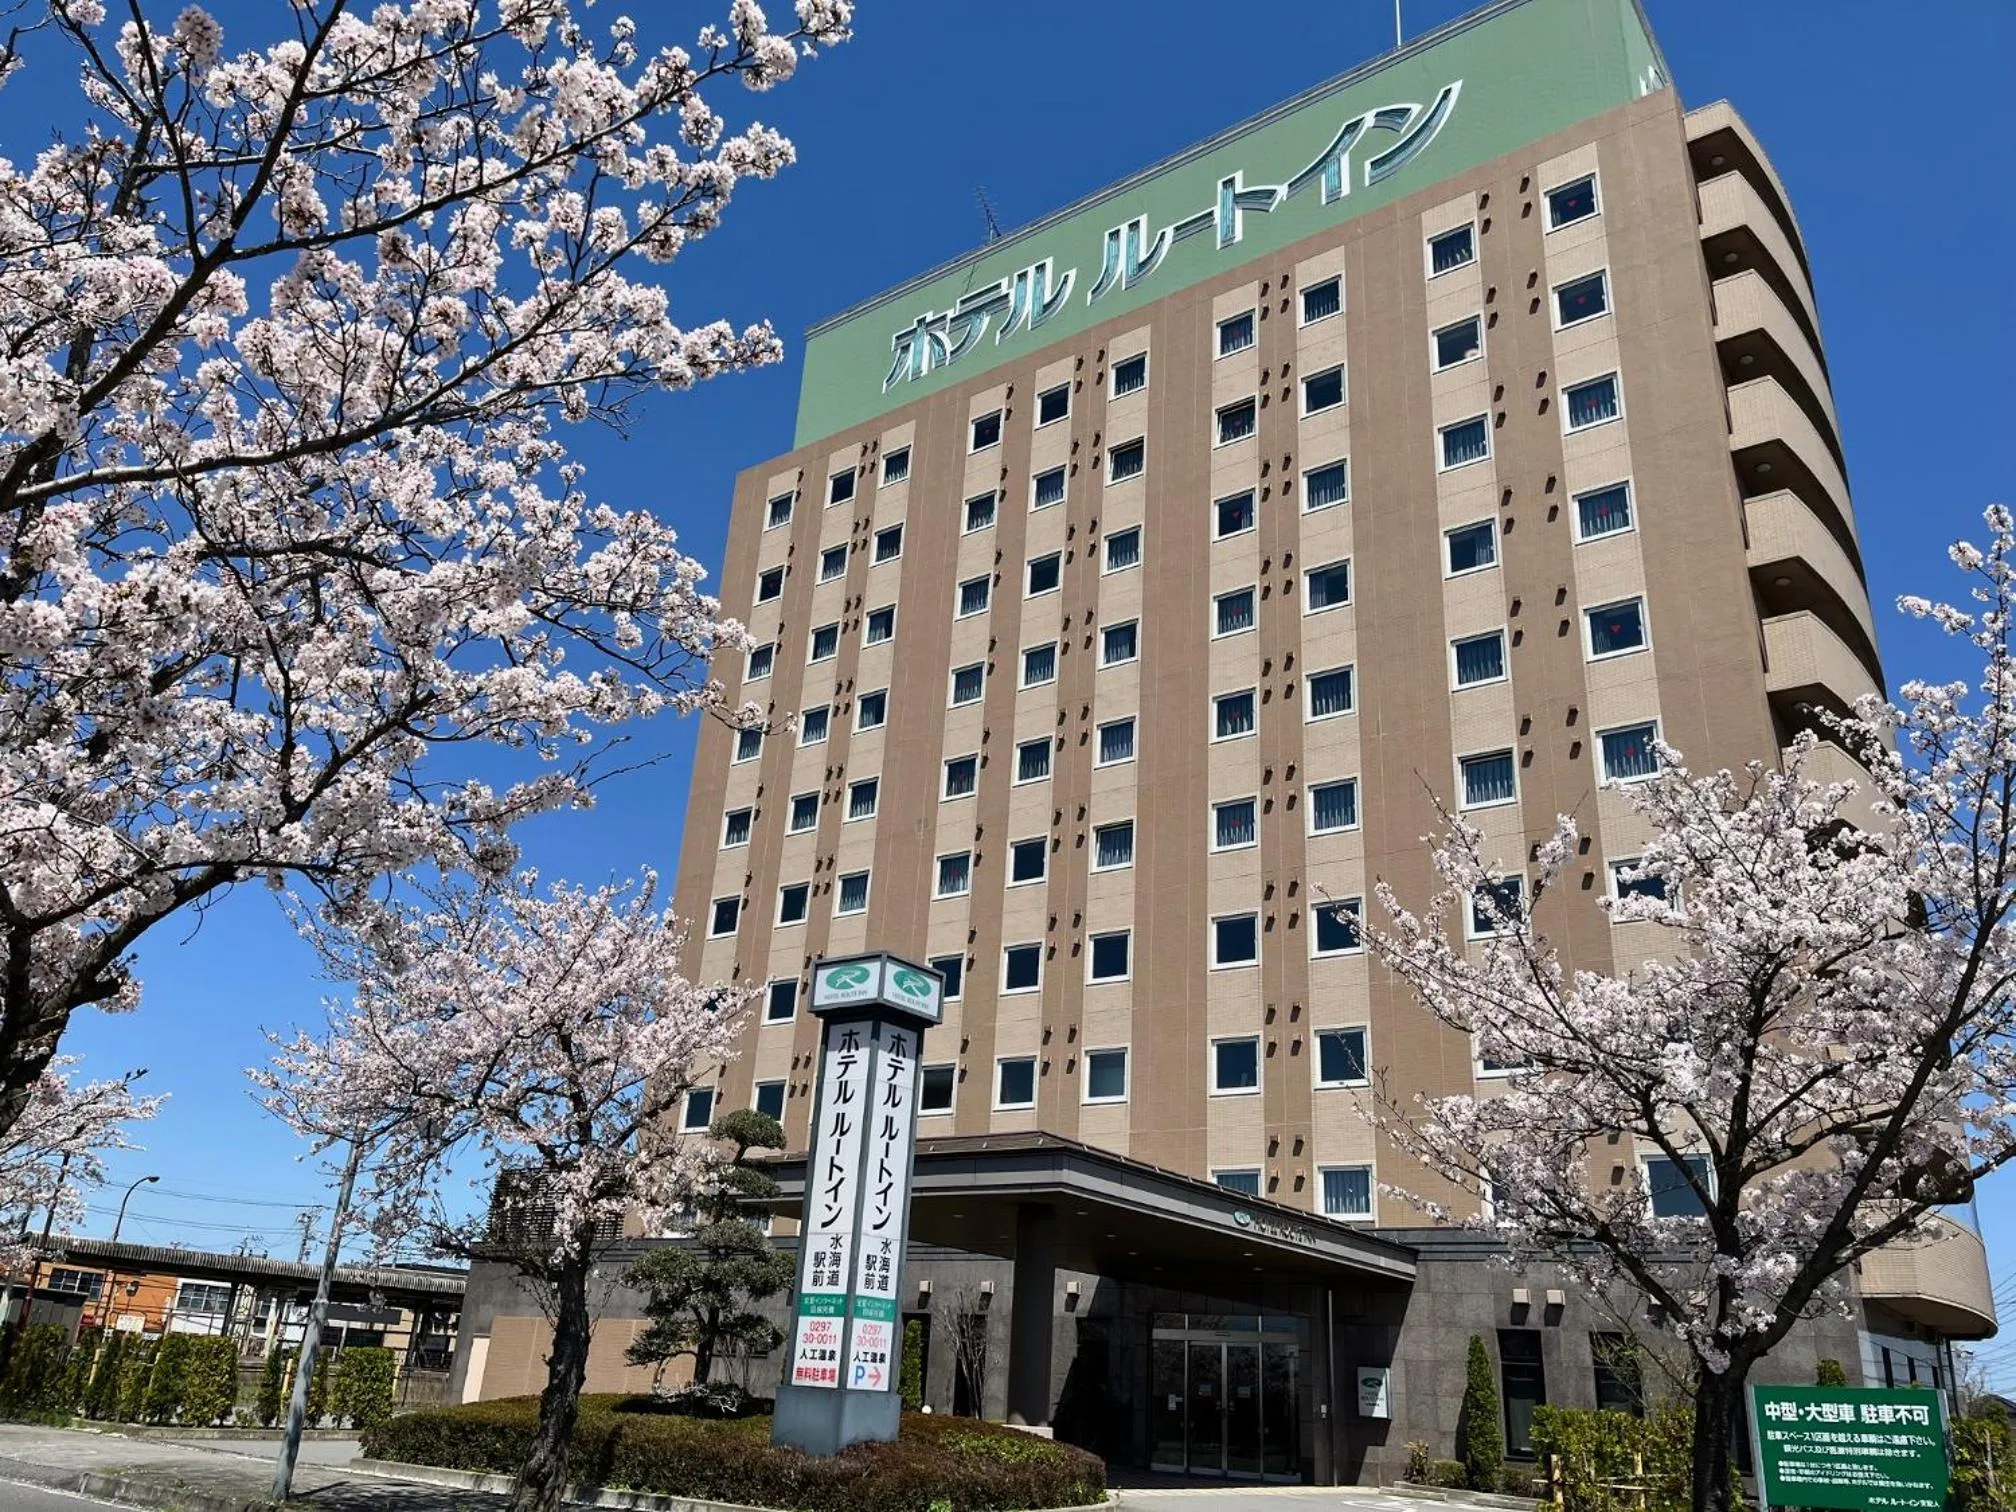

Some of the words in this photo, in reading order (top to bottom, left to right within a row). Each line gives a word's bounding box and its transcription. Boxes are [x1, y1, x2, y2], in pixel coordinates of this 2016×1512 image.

[882, 257, 1077, 394] ホテル
[1087, 79, 1463, 306] ルートイン
[833, 1028, 860, 1105] ホテル
[883, 1032, 908, 1109] ホテル
[821, 1112, 852, 1228] ルートイン
[873, 1116, 899, 1230] ルートイン
[812, 1251, 827, 1287] 駅前
[827, 1232, 844, 1286] 水海道
[864, 1254, 878, 1290] 駅前
[877, 1238, 892, 1291] 水海道
[802, 1332, 837, 1345] 30-0011
[809, 1321, 832, 1332] 0297
[856, 1335, 887, 1348] 30-0011
[862, 1323, 882, 1335] 0297
[799, 1348, 837, 1361] 人工温泉
[854, 1365, 866, 1385] P
[1764, 1401, 1855, 1424] 中型・大型車
[1860, 1404, 1929, 1426] 駐車不可
